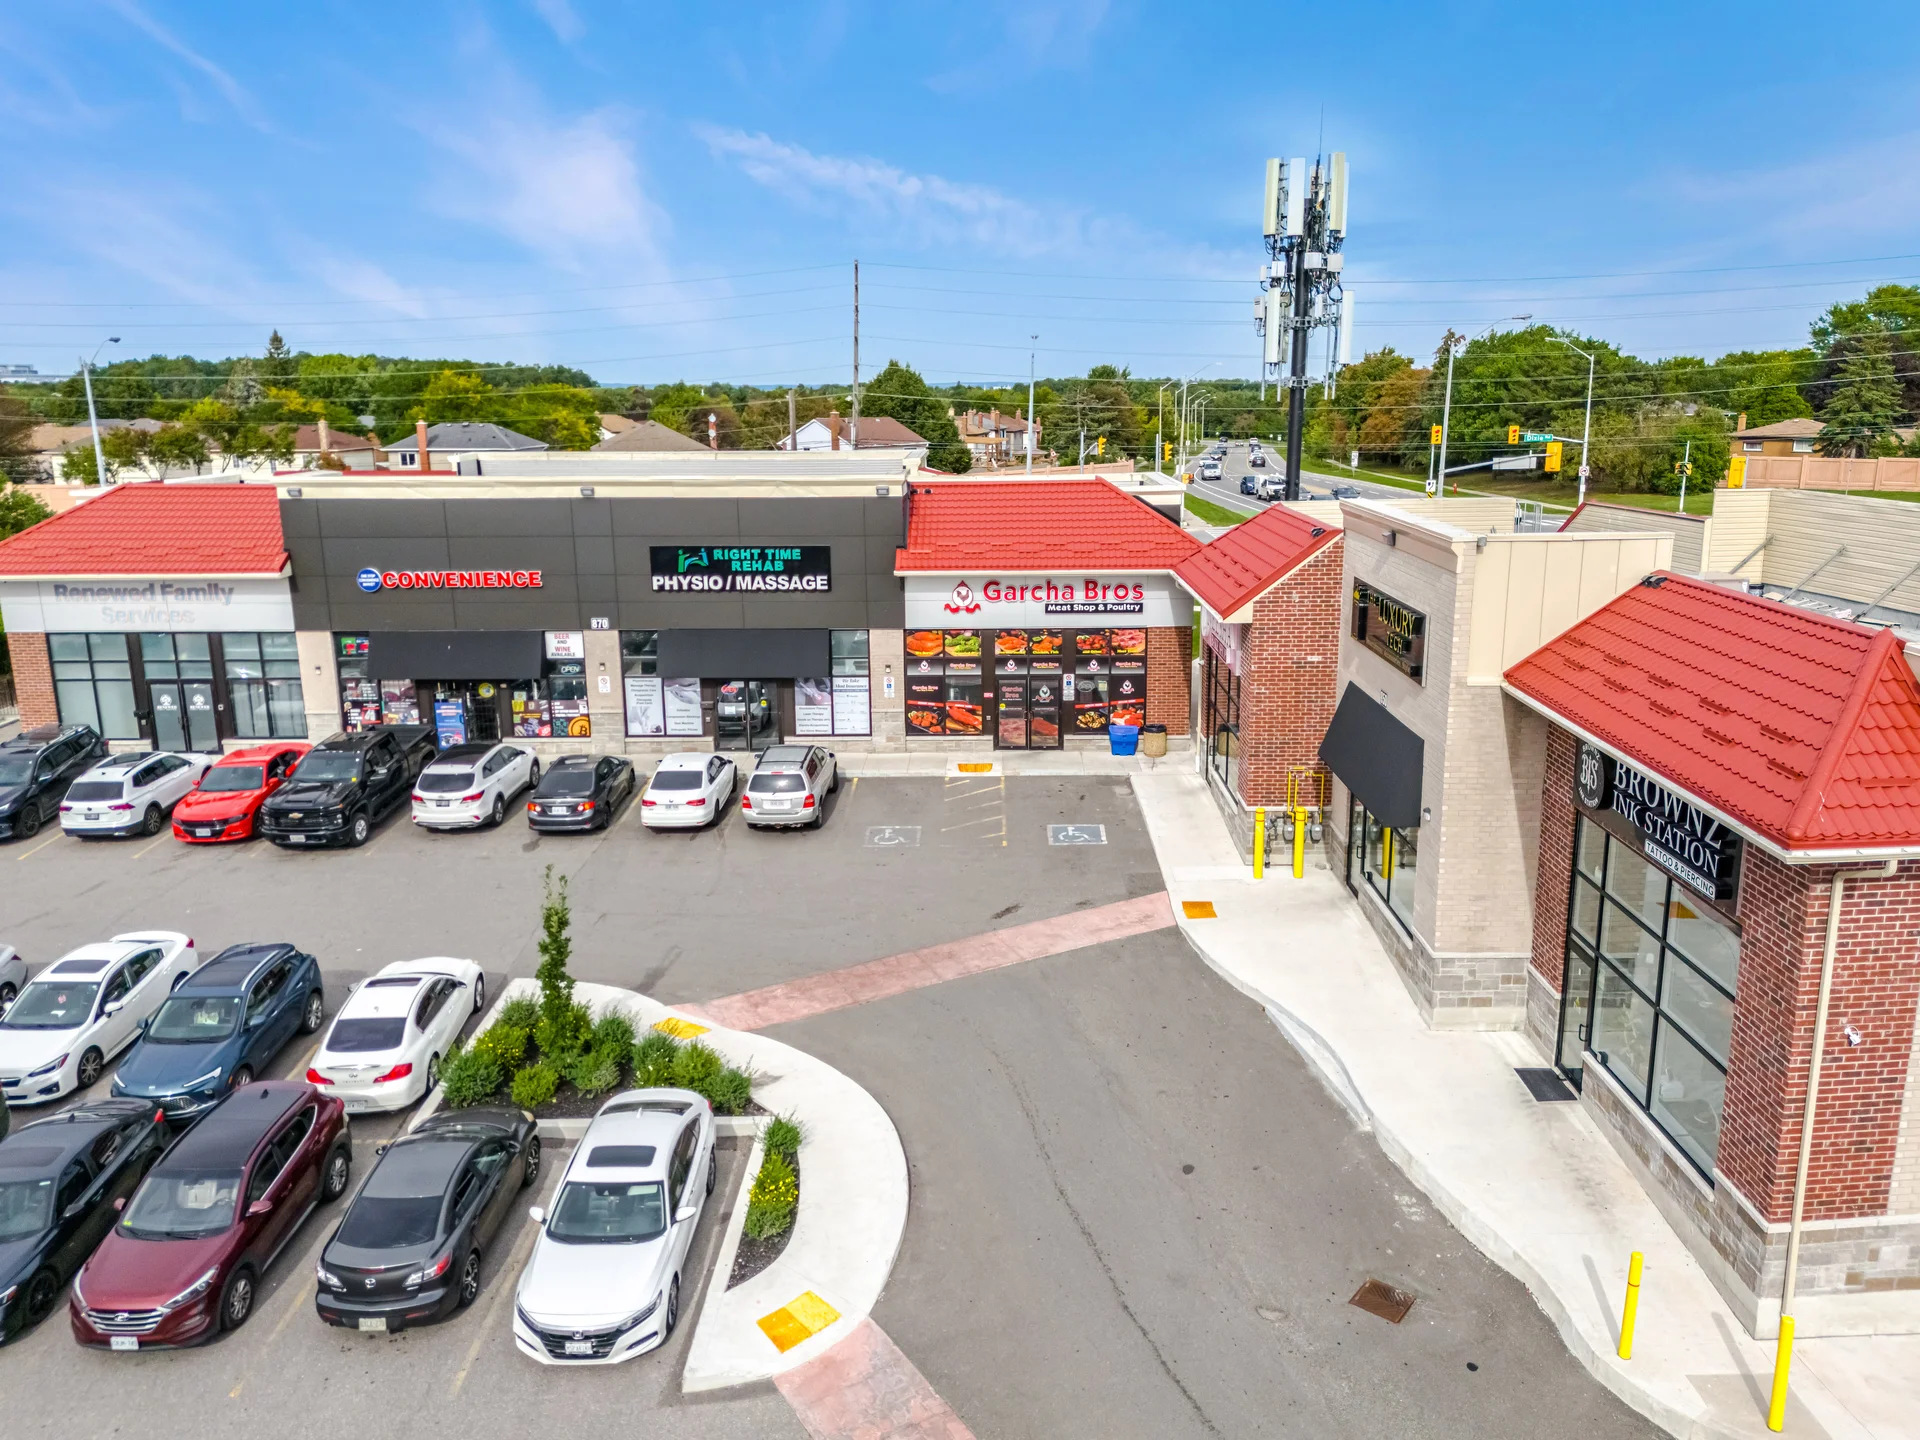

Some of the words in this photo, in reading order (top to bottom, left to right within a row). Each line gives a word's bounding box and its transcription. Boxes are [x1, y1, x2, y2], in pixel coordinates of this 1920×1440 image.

[713, 549, 760, 560] RIGHT
[765, 549, 802, 560] TIME
[731, 561, 785, 572] REHAB
[381, 571, 543, 588] CONVENIENCE
[652, 575, 723, 590] PHYSIO
[725, 575, 732, 590] /
[735, 575, 828, 590] MASSAGE
[53, 583, 156, 602] Renewed
[160, 582, 234, 606] Family
[983, 579, 1075, 602] Garcha
[1084, 579, 1144, 601] Bros
[101, 606, 196, 623] Services
[1047, 603, 1071, 611] Meat
[1073, 603, 1096, 612] Shop
[1107, 603, 1141, 612] Poultry
[591, 618, 609, 630] 870
[1378, 597, 1416, 640] LUXURY
[1386, 629, 1403, 655] TECH
[560, 665, 580, 673] OPEN
[1612, 759, 1722, 850] BROWNZ
[1612, 789, 1641, 828] INK
[1644, 811, 1720, 877] STATION
[1646, 841, 1674, 868] TATTOO
[1680, 864, 1714, 897] PIERCING
